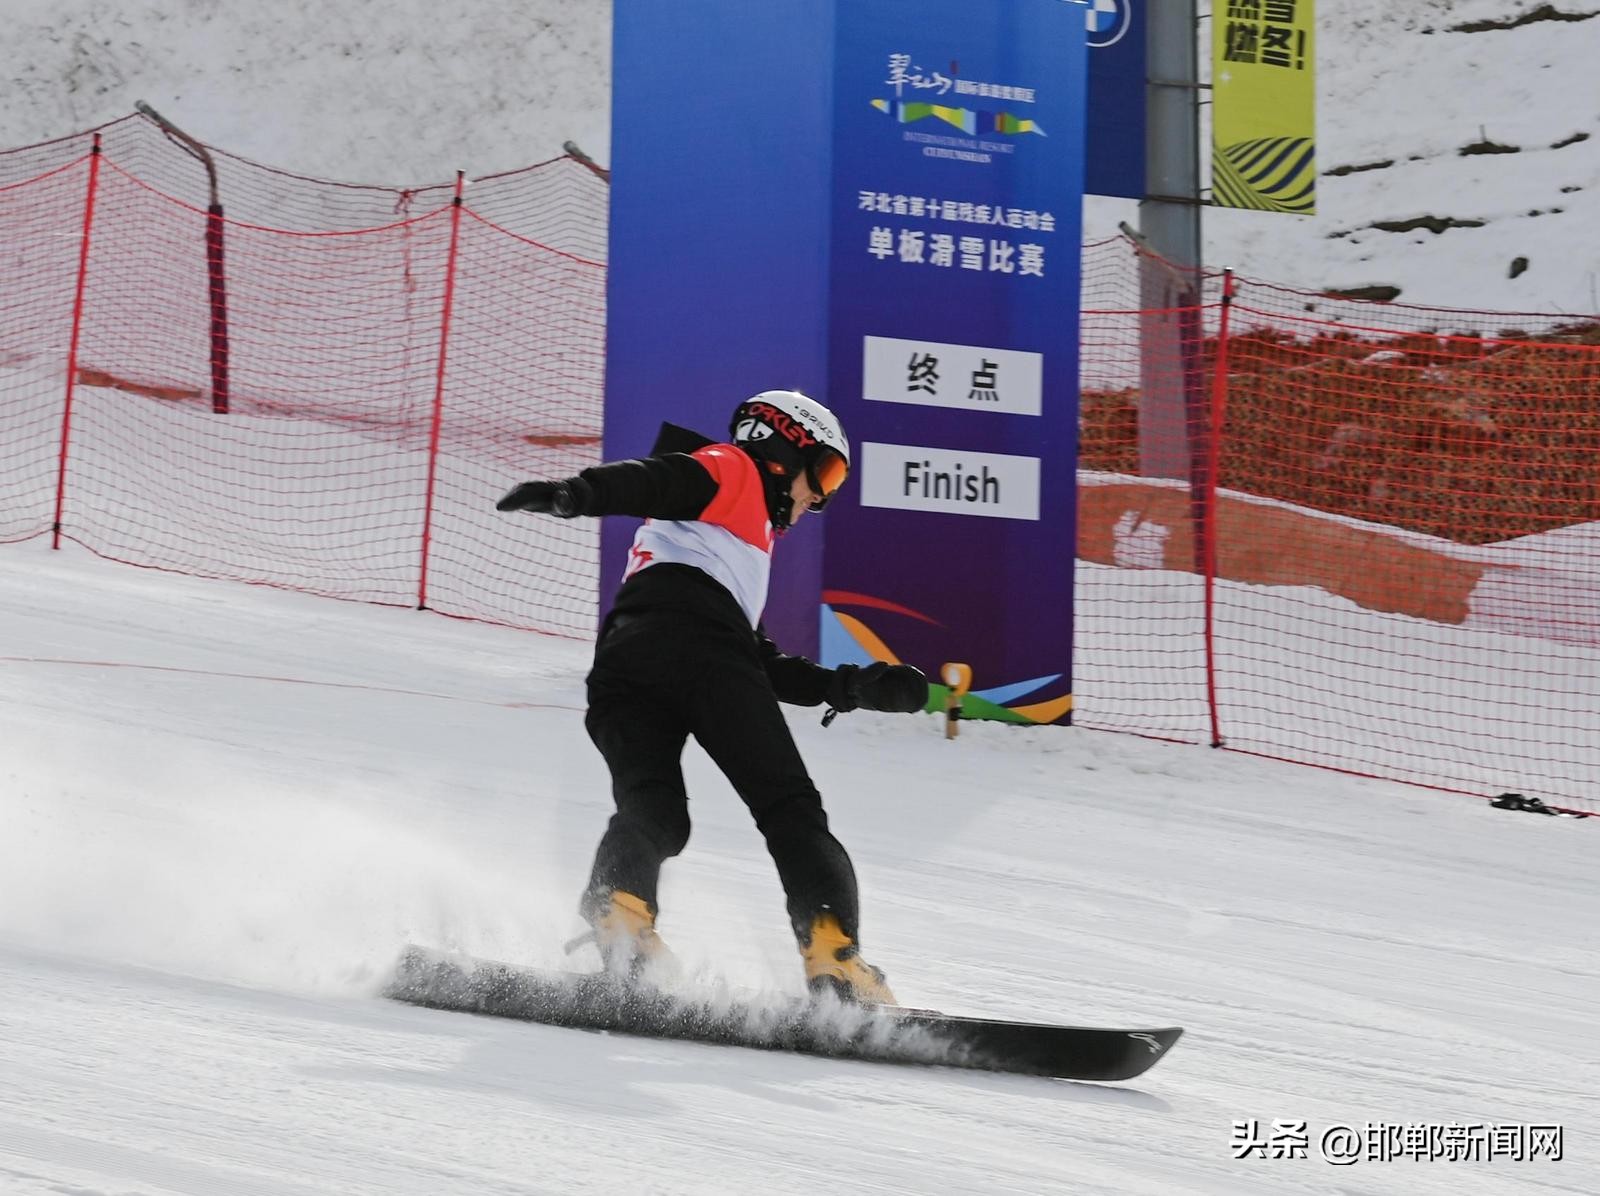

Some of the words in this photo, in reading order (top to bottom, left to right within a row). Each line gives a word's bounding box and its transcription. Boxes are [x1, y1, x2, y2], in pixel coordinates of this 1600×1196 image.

[858, 190, 1056, 232] 河北省第十届残疾人运动会
[867, 226, 1045, 277] 单板滑雪比赛
[907, 352, 1000, 401] 终点
[904, 460, 1000, 504] Finish
